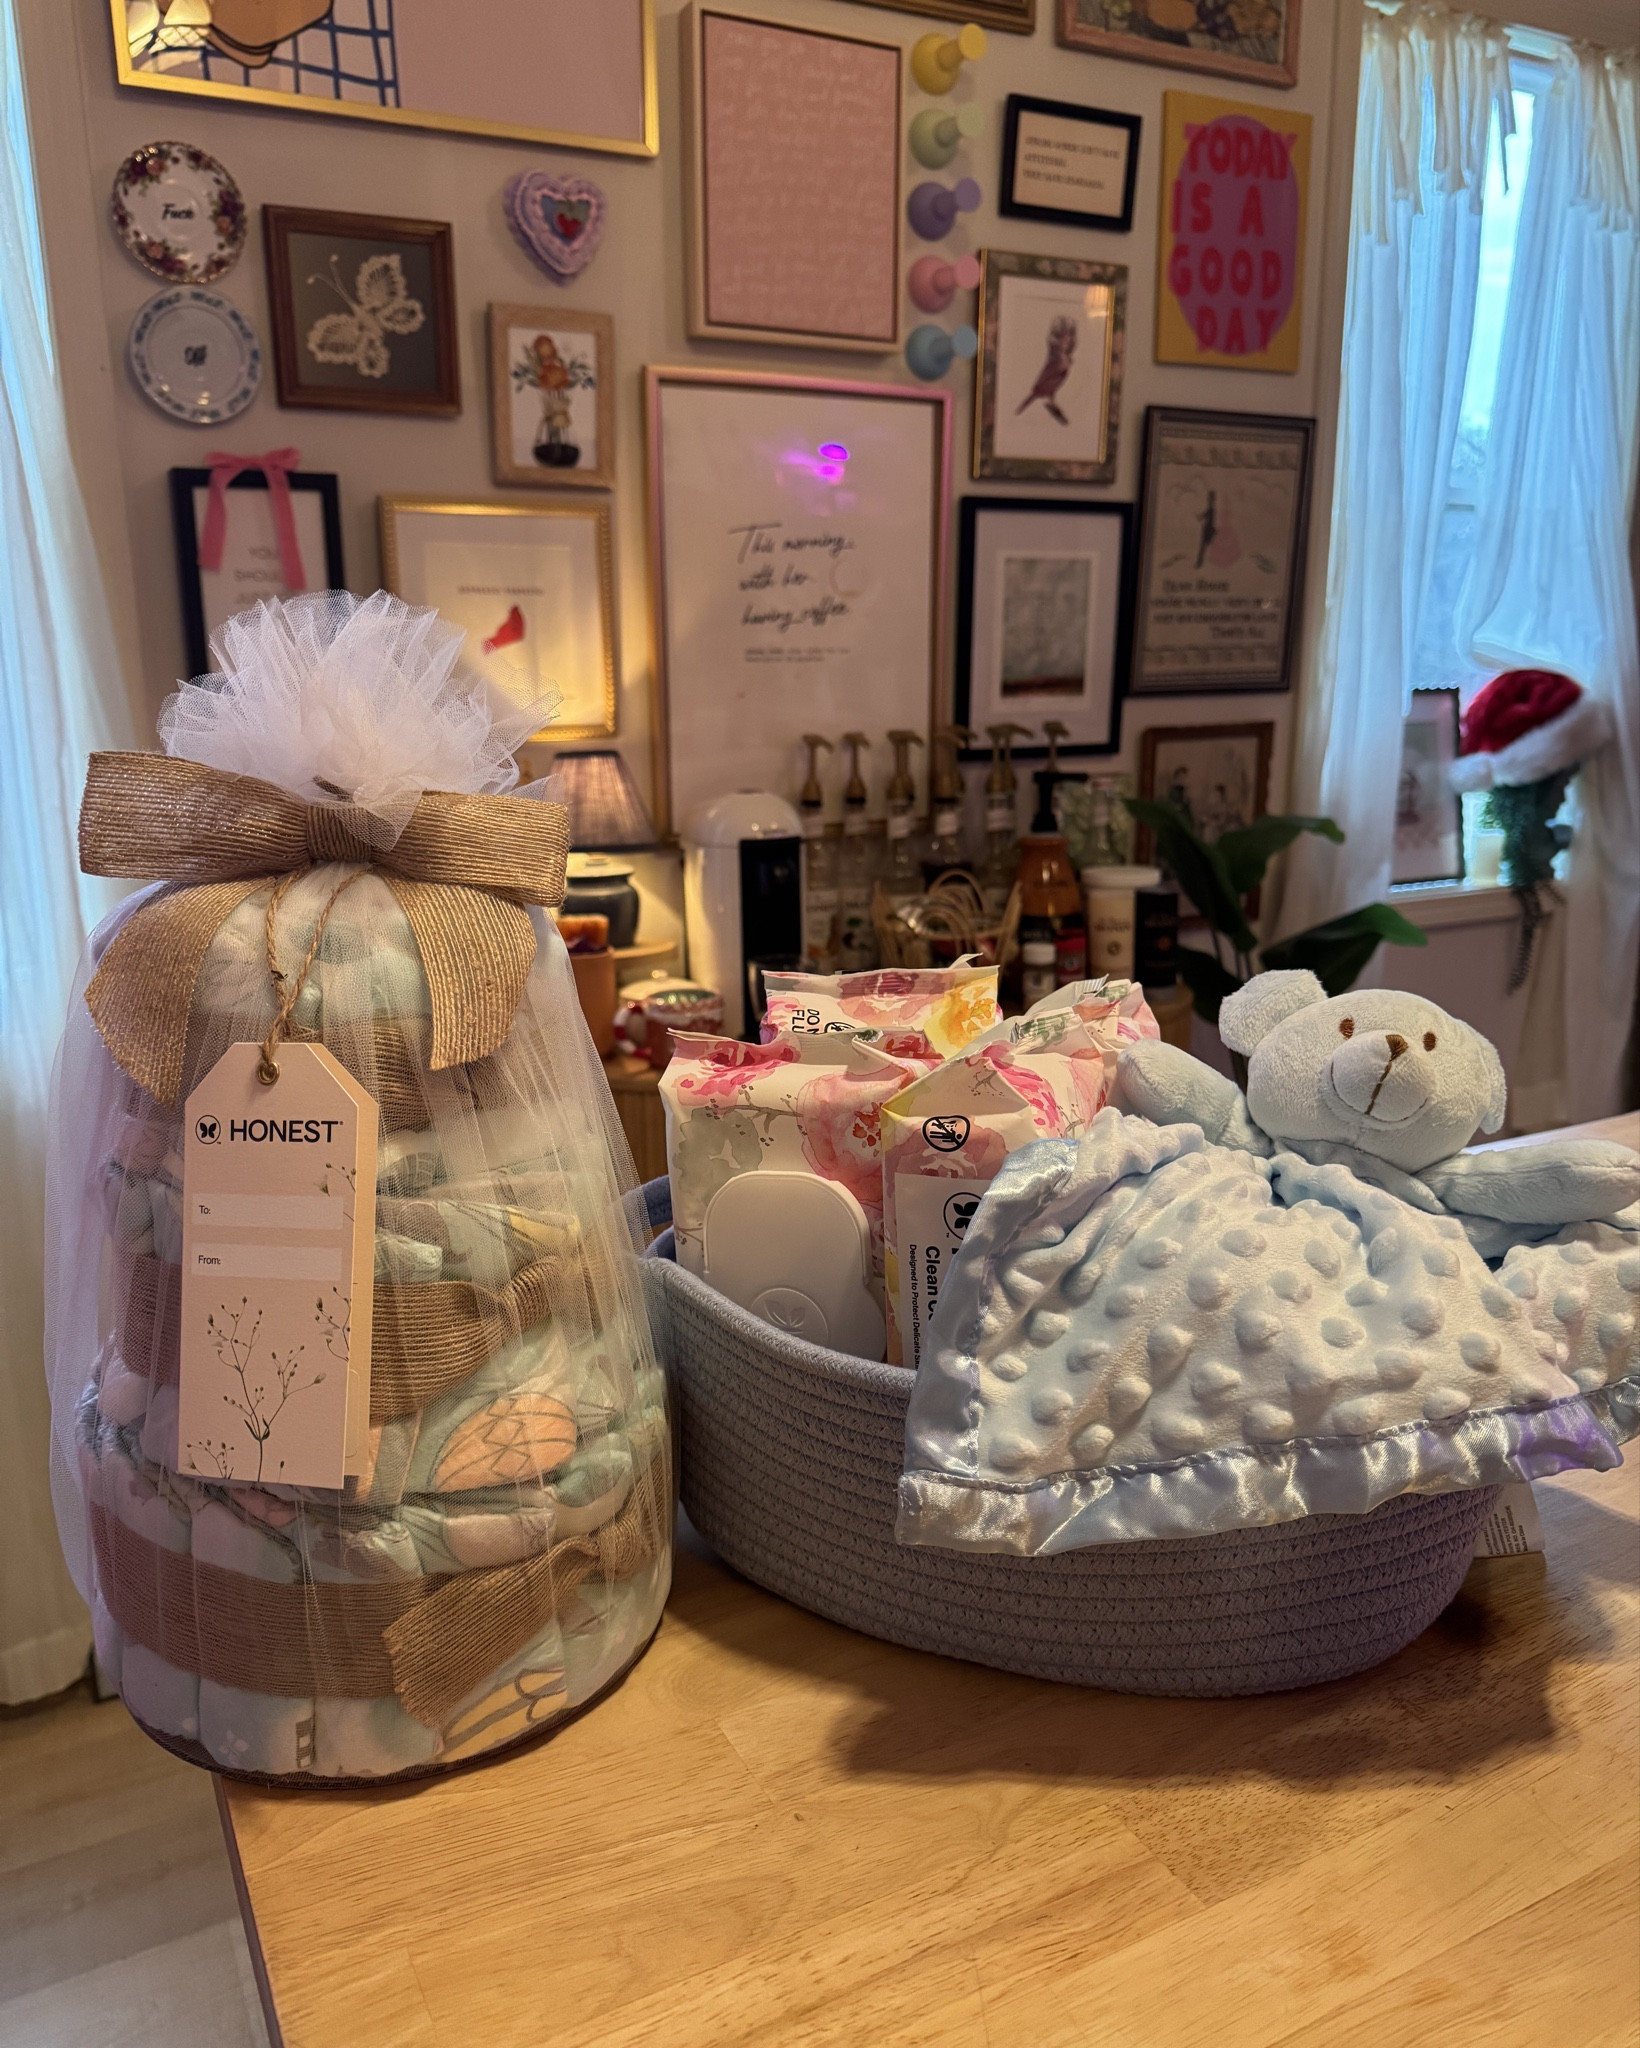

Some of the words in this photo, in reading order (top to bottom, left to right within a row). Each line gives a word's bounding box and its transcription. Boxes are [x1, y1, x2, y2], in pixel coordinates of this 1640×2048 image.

[1185, 122, 1297, 180] TODAY
[1171, 180, 1213, 233] IS
[1237, 184, 1264, 236] A
[1168, 244, 1281, 300] GOOD
[1197, 305, 1278, 354] DAY
[792, 1010, 805, 1033] FLU
[807, 1009, 820, 1025] DO
[198, 1204, 211, 1215] To:
[198, 1255, 221, 1265] From:
[909, 1244, 917, 1281] Designed
[925, 1245, 940, 1296] Clean
[911, 1282, 917, 1290] to
[911, 1291, 919, 1320] Protect
[912, 1321, 920, 1354] Delicate
